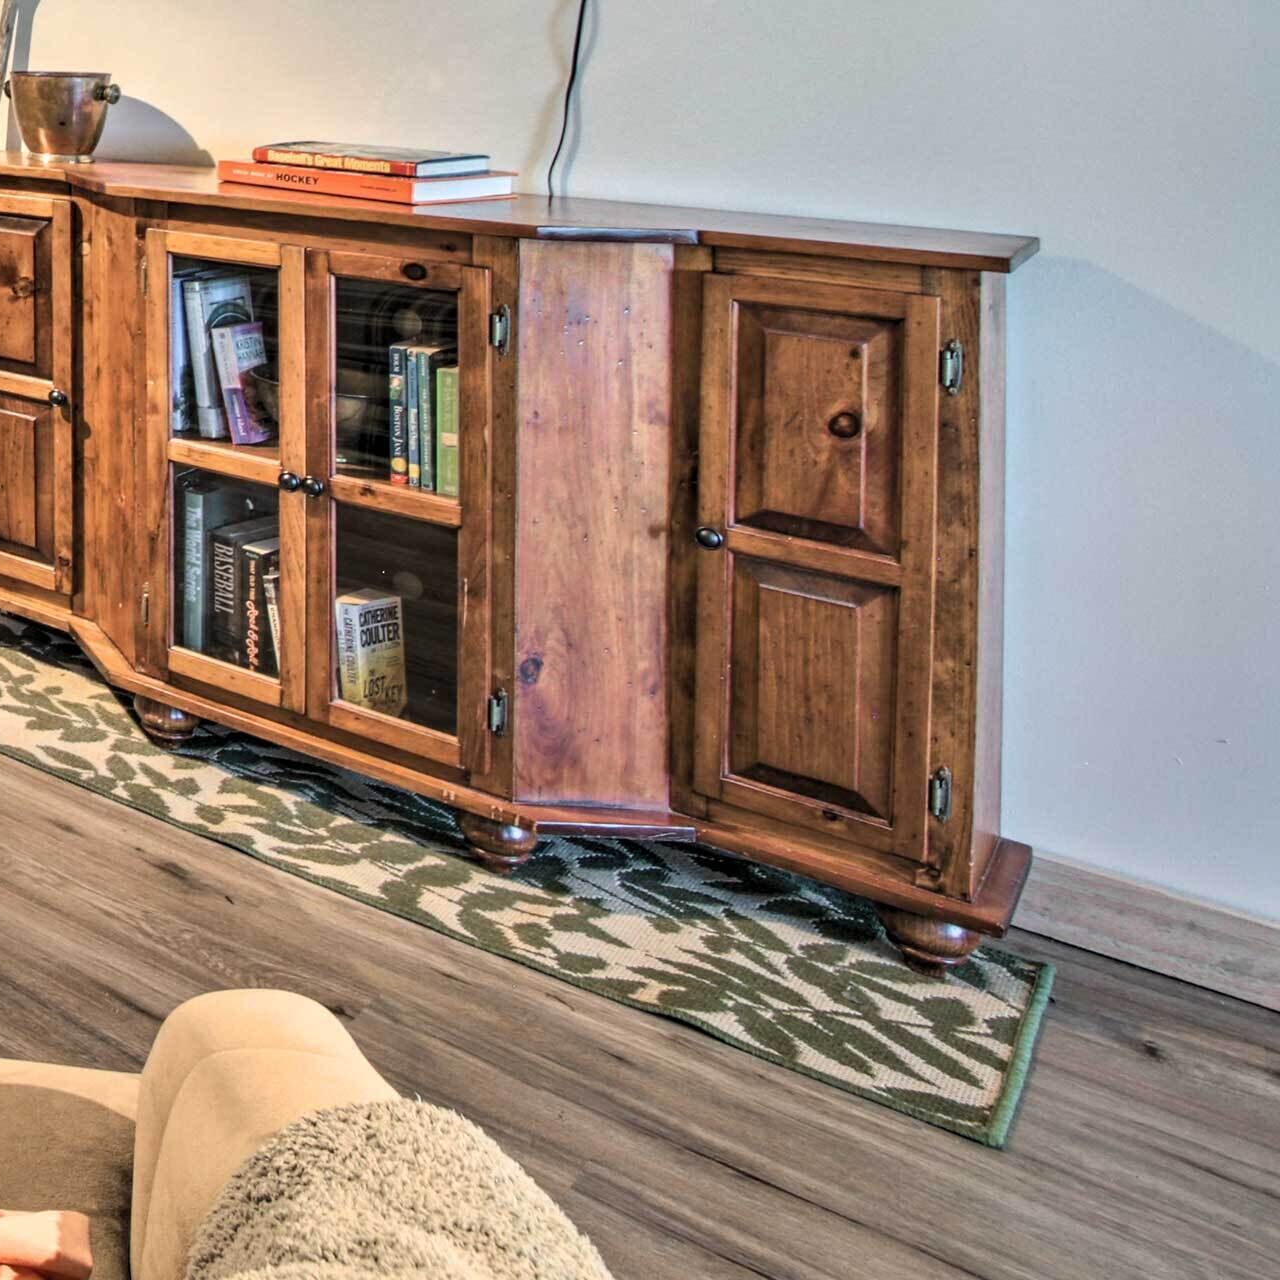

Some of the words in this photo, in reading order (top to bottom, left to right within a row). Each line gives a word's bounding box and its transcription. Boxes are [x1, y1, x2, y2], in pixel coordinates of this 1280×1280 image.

[276, 173, 320, 185] HOCKEY
[393, 405, 403, 436] BOSTON
[186, 506, 201, 528] The
[186, 529, 201, 564] World
[186, 566, 201, 603] Series
[214, 543, 234, 614] BASEBALL
[359, 606, 399, 627] CATHERINE
[360, 622, 400, 648] COULTER
[363, 675, 386, 699] LOST
